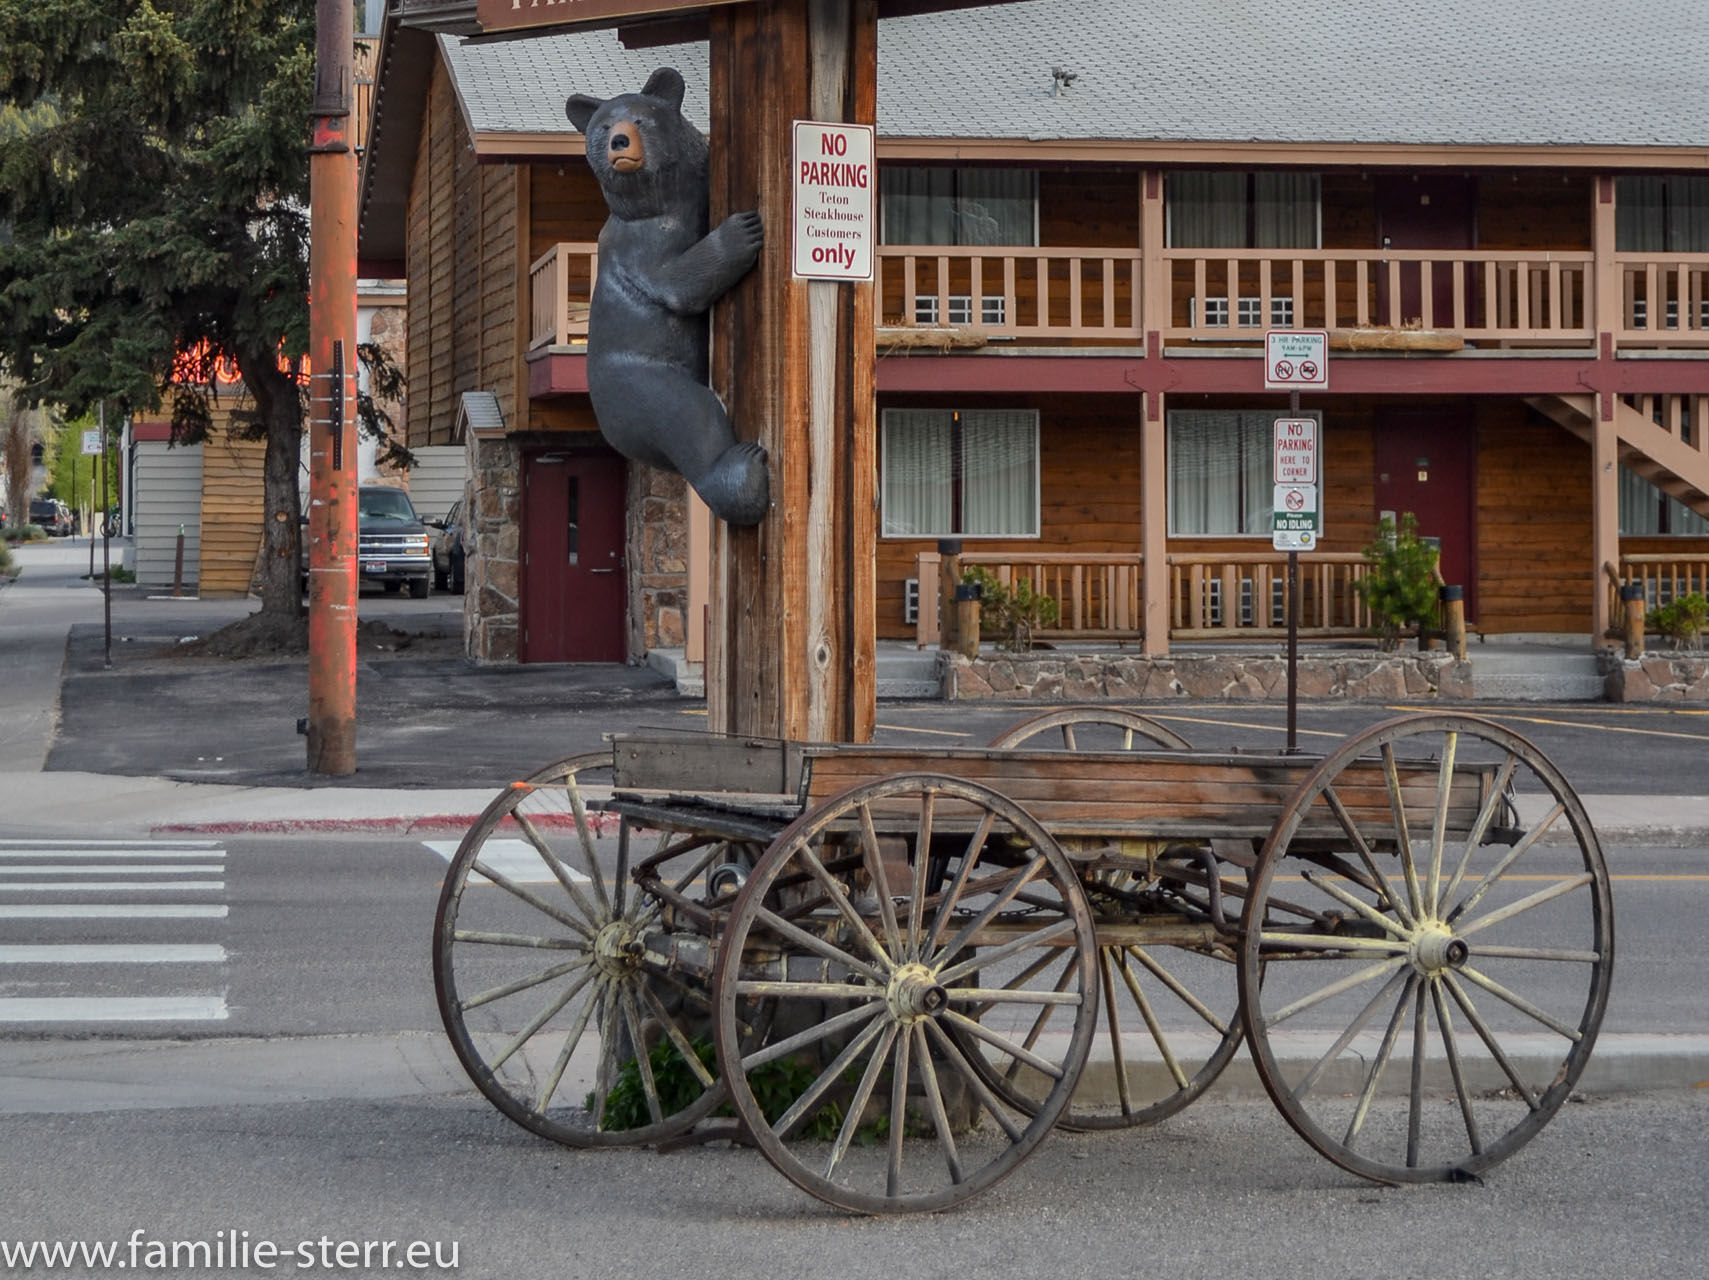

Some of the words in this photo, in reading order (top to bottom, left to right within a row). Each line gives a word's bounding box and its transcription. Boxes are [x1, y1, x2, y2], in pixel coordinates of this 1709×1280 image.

[821, 132, 848, 157] NO
[800, 160, 868, 189] PARKING
[818, 191, 849, 206] Teton
[803, 207, 864, 222] Steakhouse
[806, 225, 862, 240] Customers
[811, 242, 856, 270] only
[1278, 336, 1289, 344] HR
[1291, 336, 1323, 344] PARKING
[1287, 424, 1303, 436] NO
[1278, 439, 1313, 451] PARKING
[1280, 456, 1296, 465] HERE
[1302, 456, 1310, 465] TO
[1282, 467, 1307, 476] CORNER
[1276, 519, 1288, 529] NO
[1288, 519, 1313, 529] IDLING
